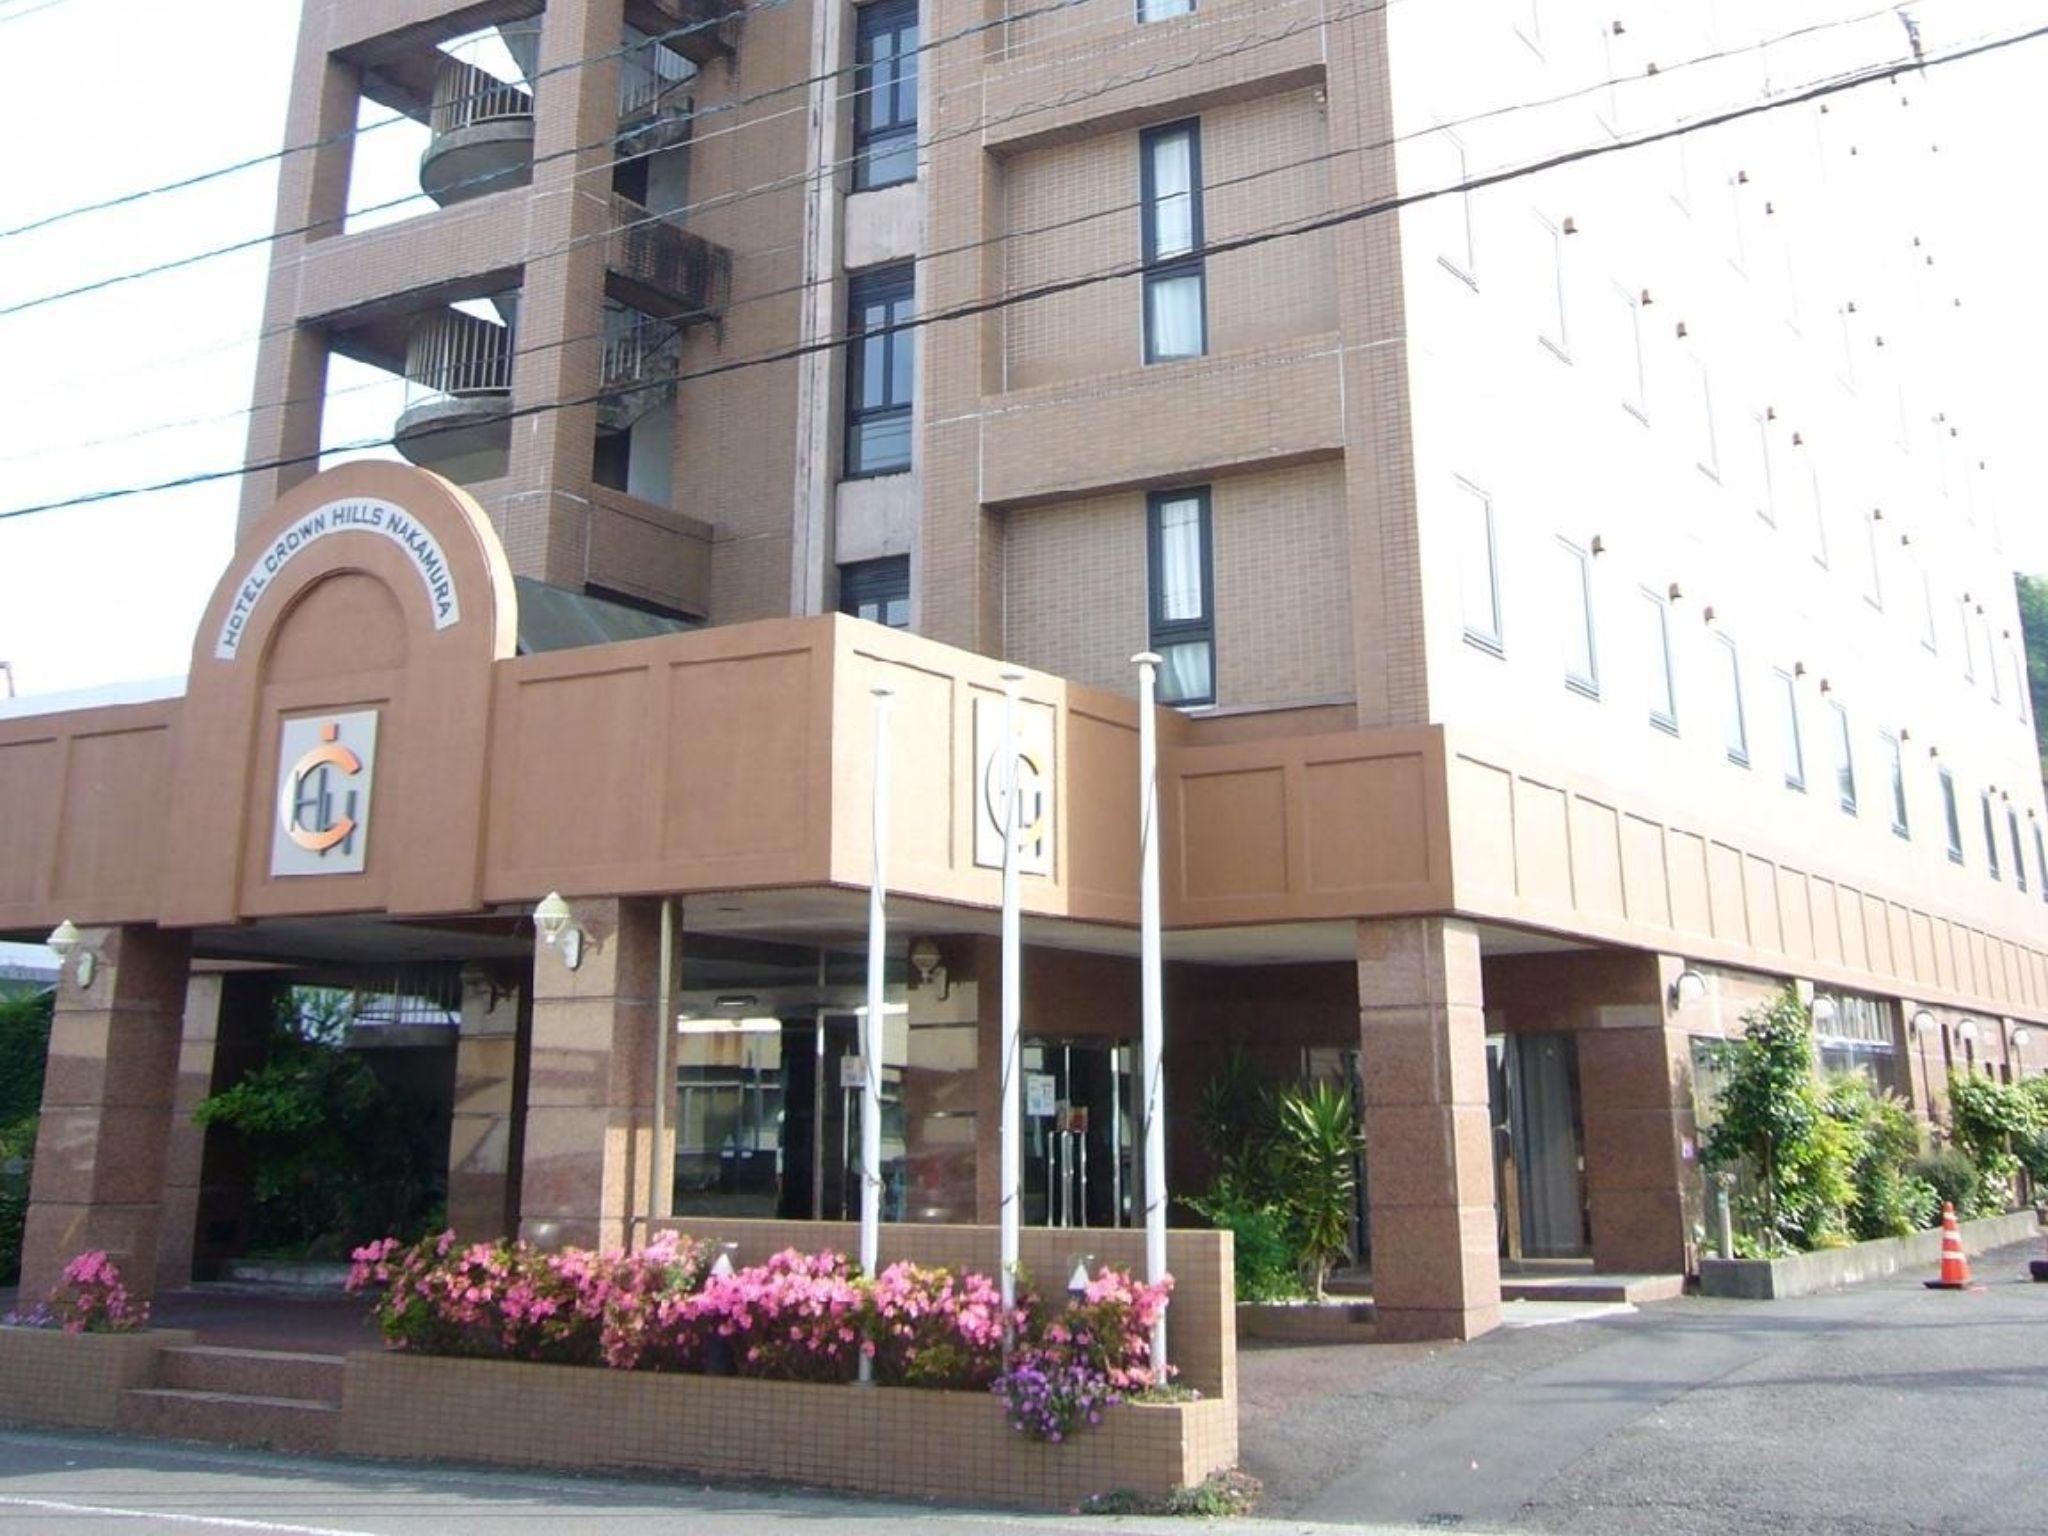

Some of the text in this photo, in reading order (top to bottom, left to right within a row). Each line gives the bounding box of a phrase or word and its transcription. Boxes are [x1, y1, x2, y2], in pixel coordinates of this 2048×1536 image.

[223, 505, 452, 647] HOTEL CROWN HILLS NAKAMURA
